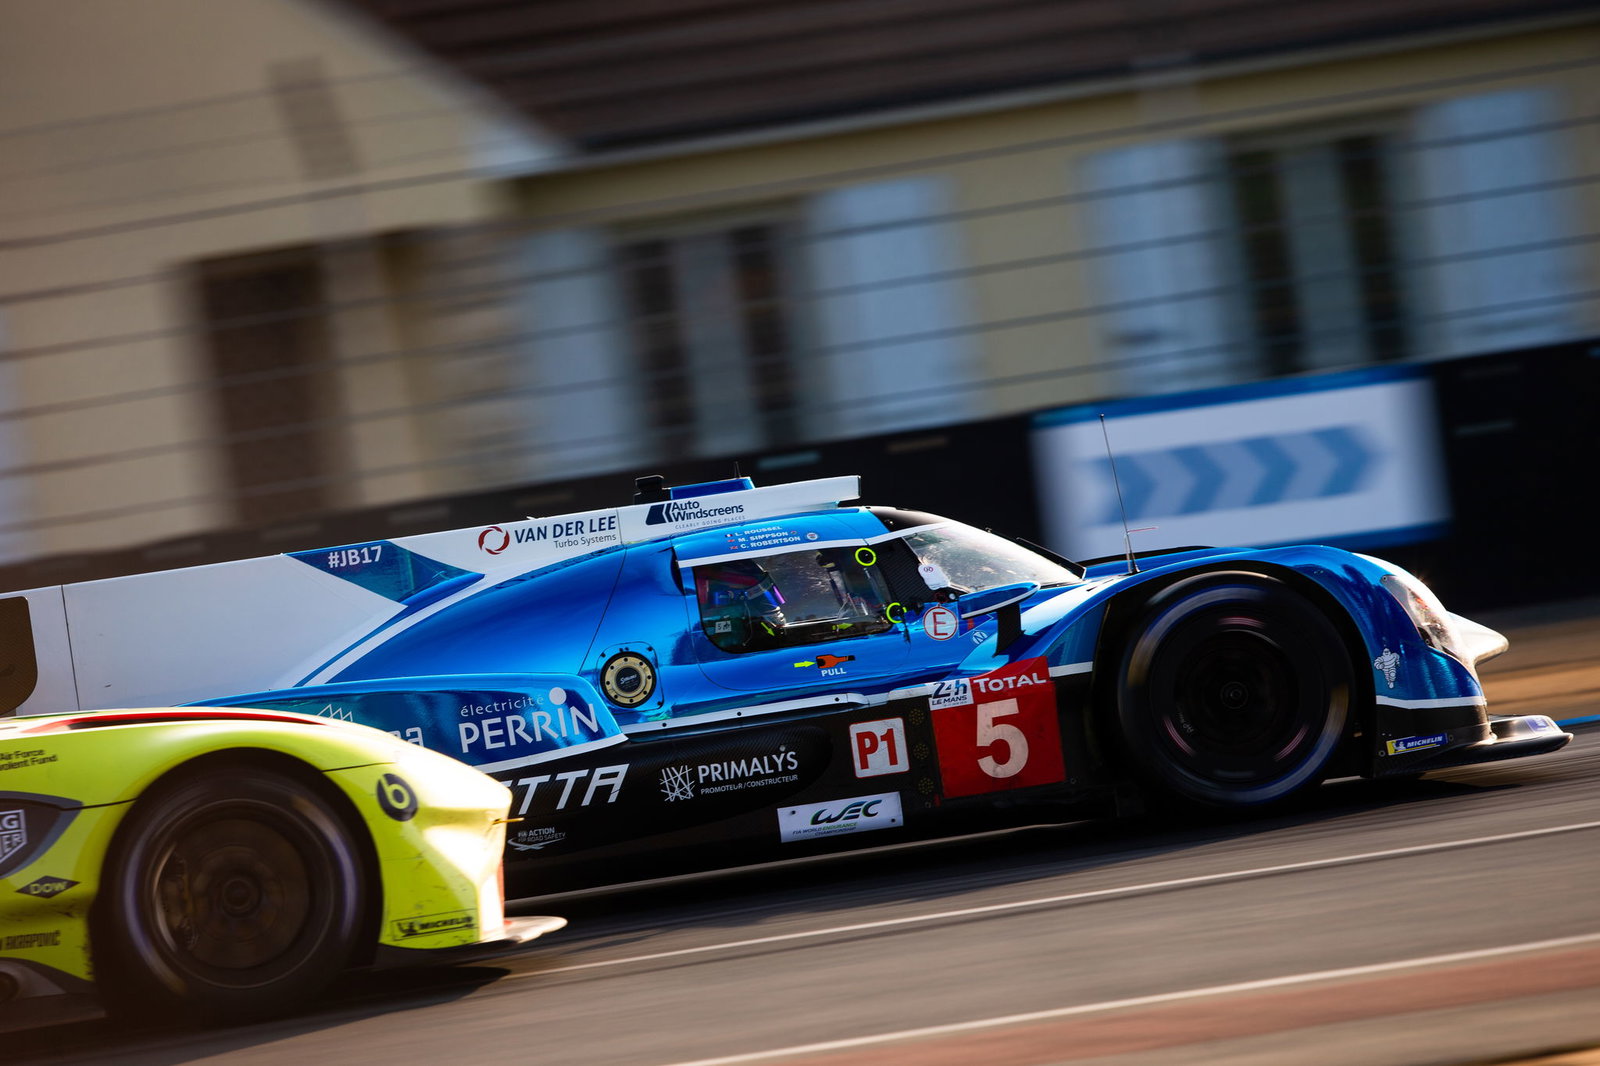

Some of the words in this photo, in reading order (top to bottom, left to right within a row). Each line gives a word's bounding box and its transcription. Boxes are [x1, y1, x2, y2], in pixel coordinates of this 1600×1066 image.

[671, 501, 700, 512] Auto
[672, 503, 744, 522] Windscreens
[702, 518, 722, 527] GOING
[724, 515, 746, 524] PLACES
[514, 525, 547, 544] VAN
[552, 520, 585, 538] DER
[589, 515, 617, 533] LEE
[744, 526, 782, 535] ROUSSEL
[749, 531, 788, 541] SIMPSON
[553, 538, 579, 549] Turbo
[580, 533, 617, 546] Systems
[750, 536, 801, 548] ROBERTSON
[328, 546, 382, 569] #JB17
[932, 611, 948, 636] E
[821, 667, 847, 677] PULL
[973, 672, 1047, 693] TOTAL
[460, 695, 544, 717] électricité
[943, 695, 968, 703] MANS
[458, 687, 599, 753] PERRIN
[976, 697, 1029, 778] 5
[1407, 736, 1443, 747] MICHELIN
[855, 728, 899, 770] P1
[31, 754, 58, 765] Fund
[697, 746, 799, 784] PRIMALYS
[500, 763, 630, 815] TTA
[810, 799, 883, 825] WEC
[0, 814, 19, 830] G
[822, 822, 858, 831] ENDURANCE
[528, 826, 555, 837] ACTION
[543, 832, 566, 840] SAFETY
[815, 827, 857, 836] CHAMPIONSHIP
